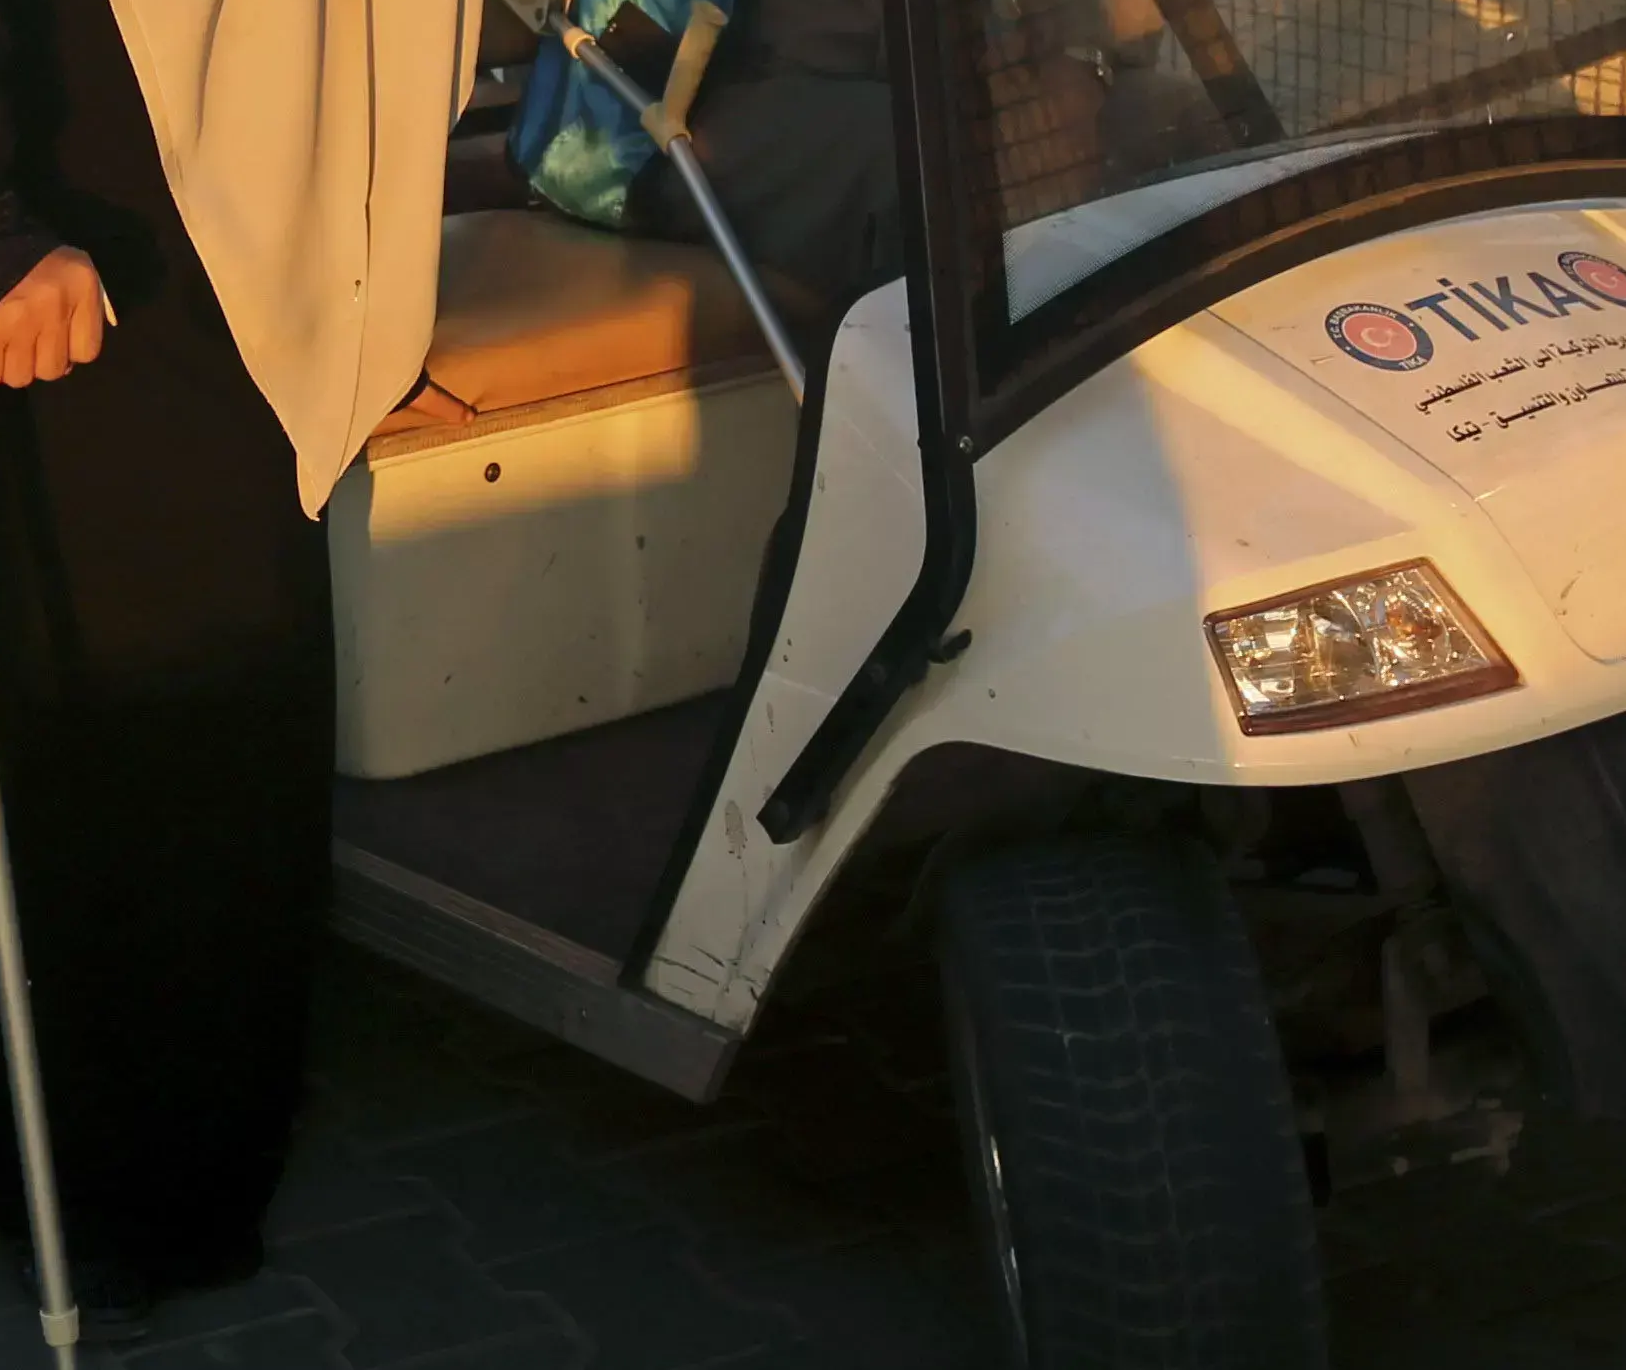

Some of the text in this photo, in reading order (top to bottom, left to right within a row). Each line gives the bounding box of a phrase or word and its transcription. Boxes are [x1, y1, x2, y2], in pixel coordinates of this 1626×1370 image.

[1404, 272, 1604, 342] TİKA
[1548, 337, 1606, 357] التركية
[1486, 357, 1532, 383] الشعب
[1415, 371, 1488, 415] الفلسطيني
[1489, 391, 1571, 429] والتنسيق
[1446, 421, 1483, 443] تيكا
